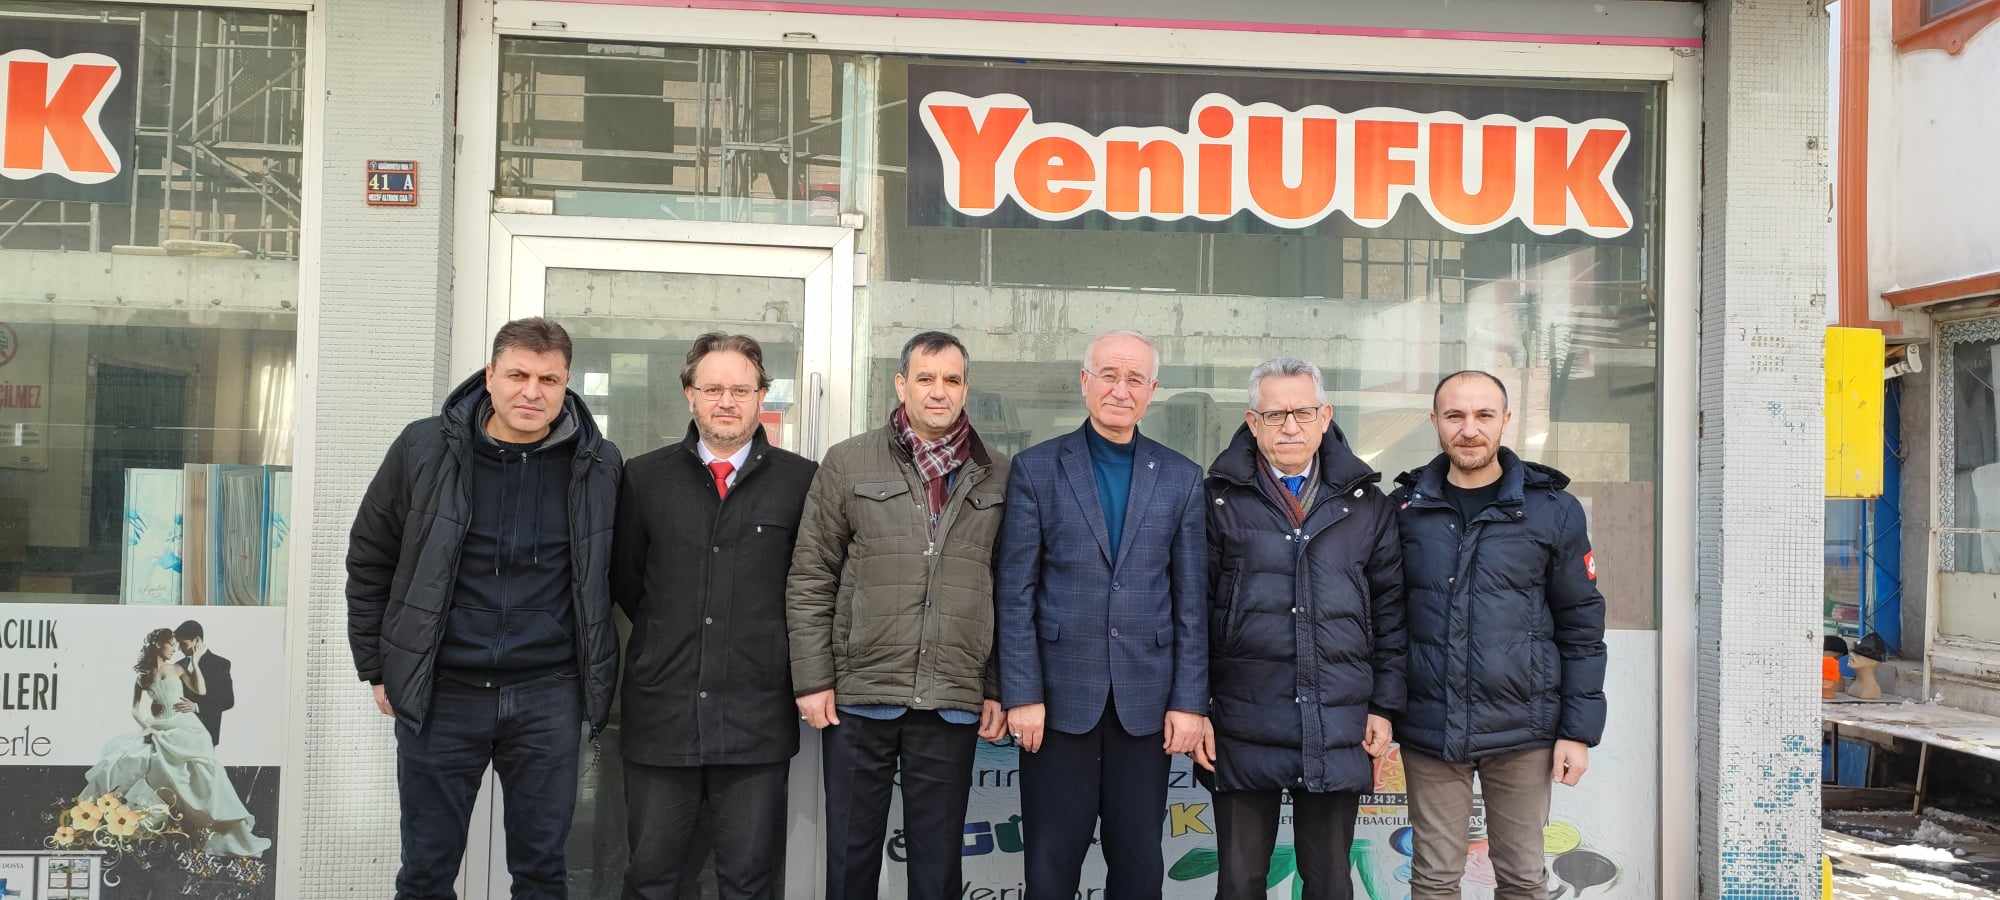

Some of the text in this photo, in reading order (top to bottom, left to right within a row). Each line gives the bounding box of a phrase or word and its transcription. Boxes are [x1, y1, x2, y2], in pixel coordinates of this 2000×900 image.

[927, 104, 1630, 229] YeniUFUK
[368, 173, 414, 191] 41 A
[0, 618, 58, 649] CILIK
[1360, 794, 1371, 804] 17
[1357, 816, 1410, 826] TBAACILI
